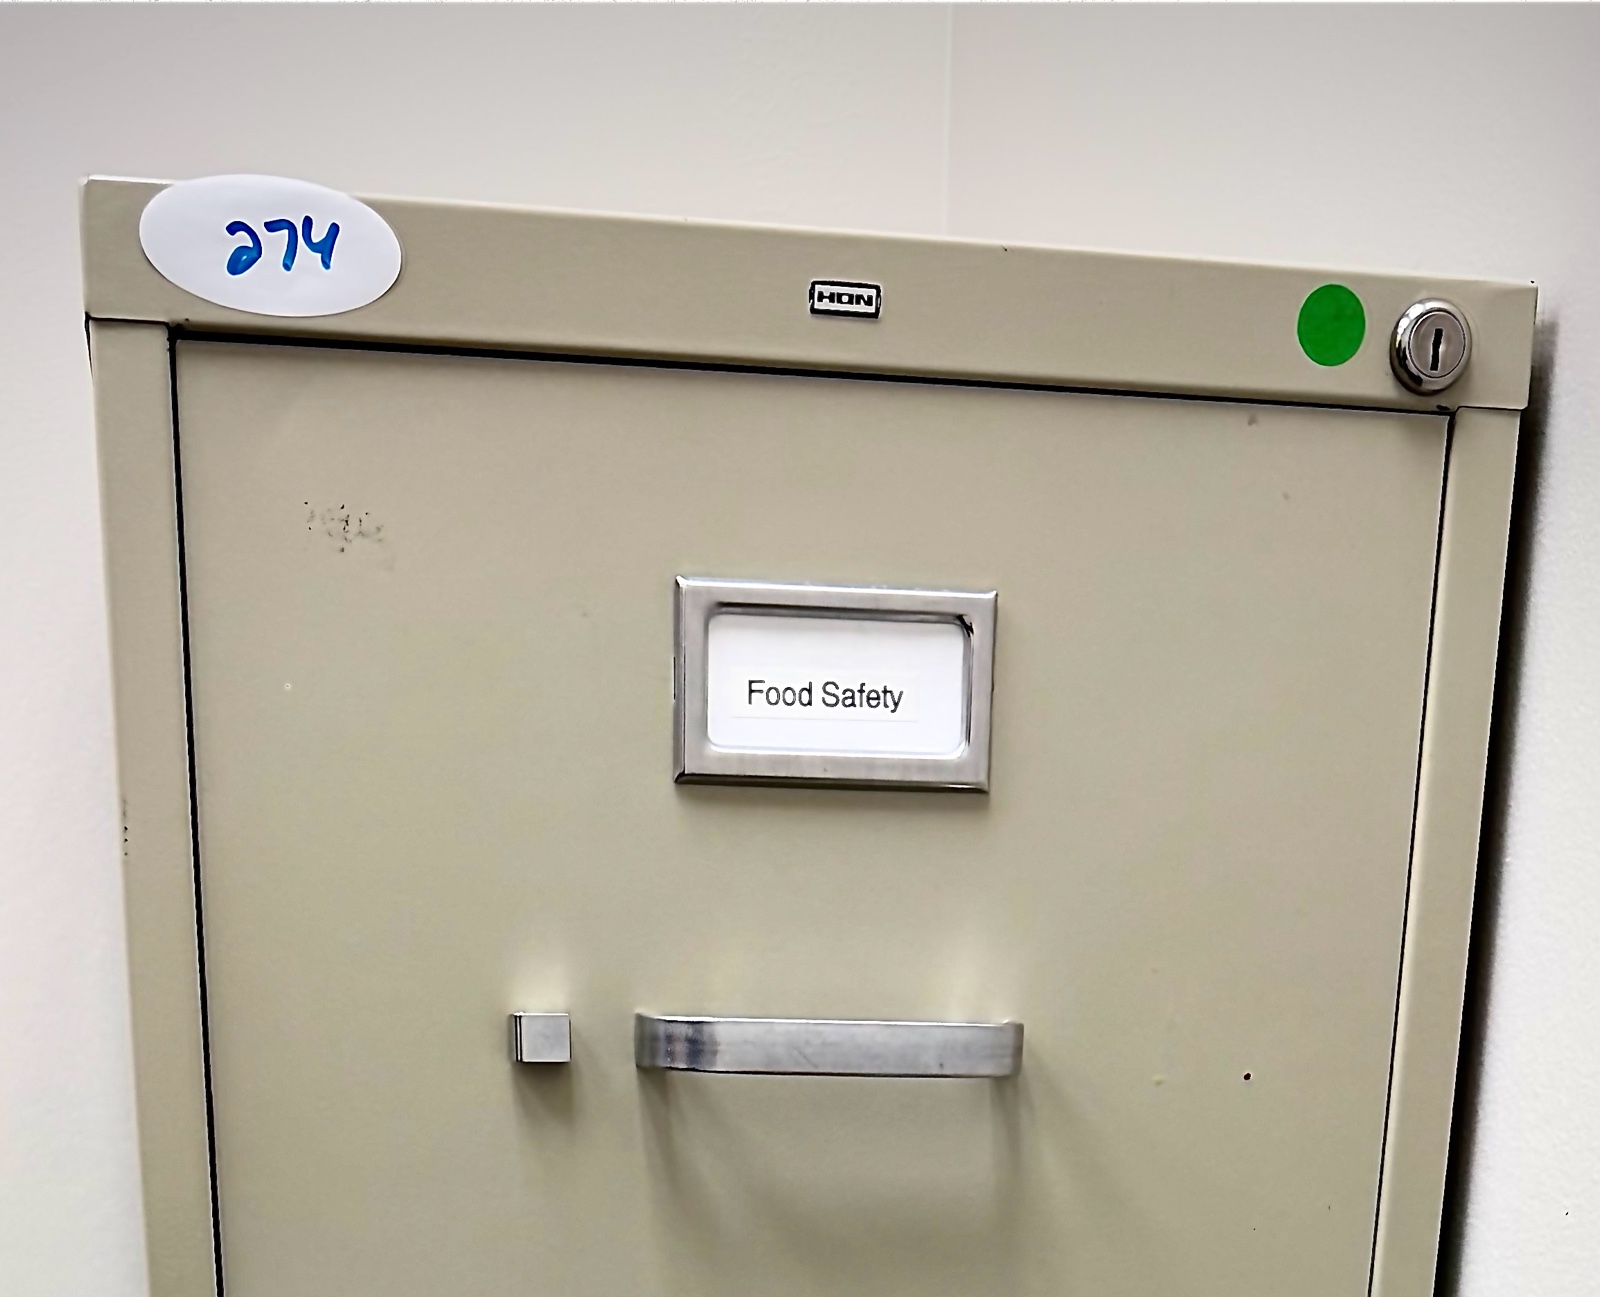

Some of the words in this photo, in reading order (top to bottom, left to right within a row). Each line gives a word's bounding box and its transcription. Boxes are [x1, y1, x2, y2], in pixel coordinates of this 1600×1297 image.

[225, 214, 340, 276] 274
[816, 290, 874, 307] HON
[747, 679, 813, 707] Food
[821, 681, 904, 713] Safety
